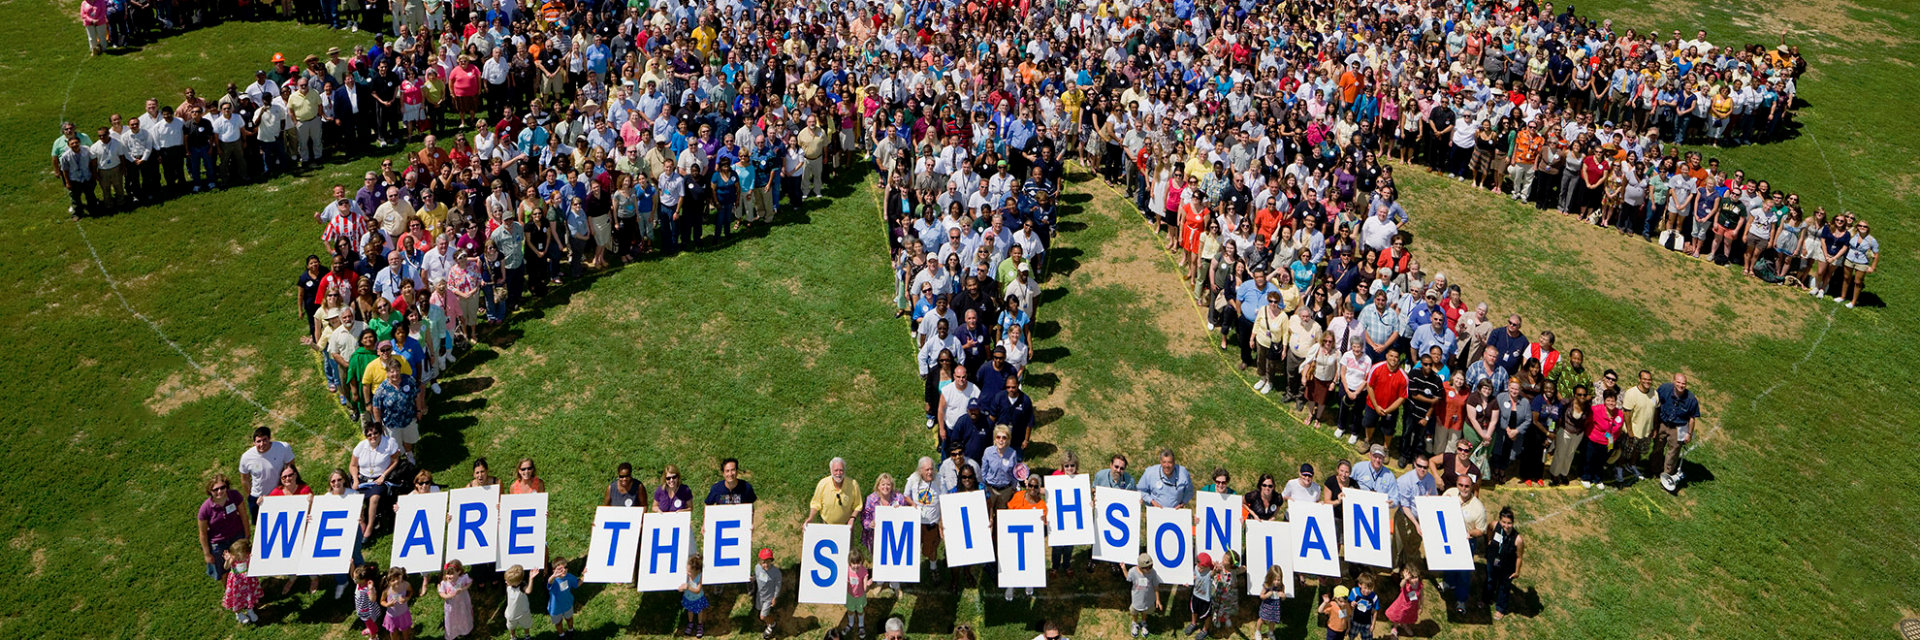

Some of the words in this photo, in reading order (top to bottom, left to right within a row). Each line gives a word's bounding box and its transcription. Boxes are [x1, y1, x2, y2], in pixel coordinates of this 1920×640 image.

[260, 510, 349, 560] WE
[399, 502, 536, 558] ARE
[603, 519, 741, 574] THE
